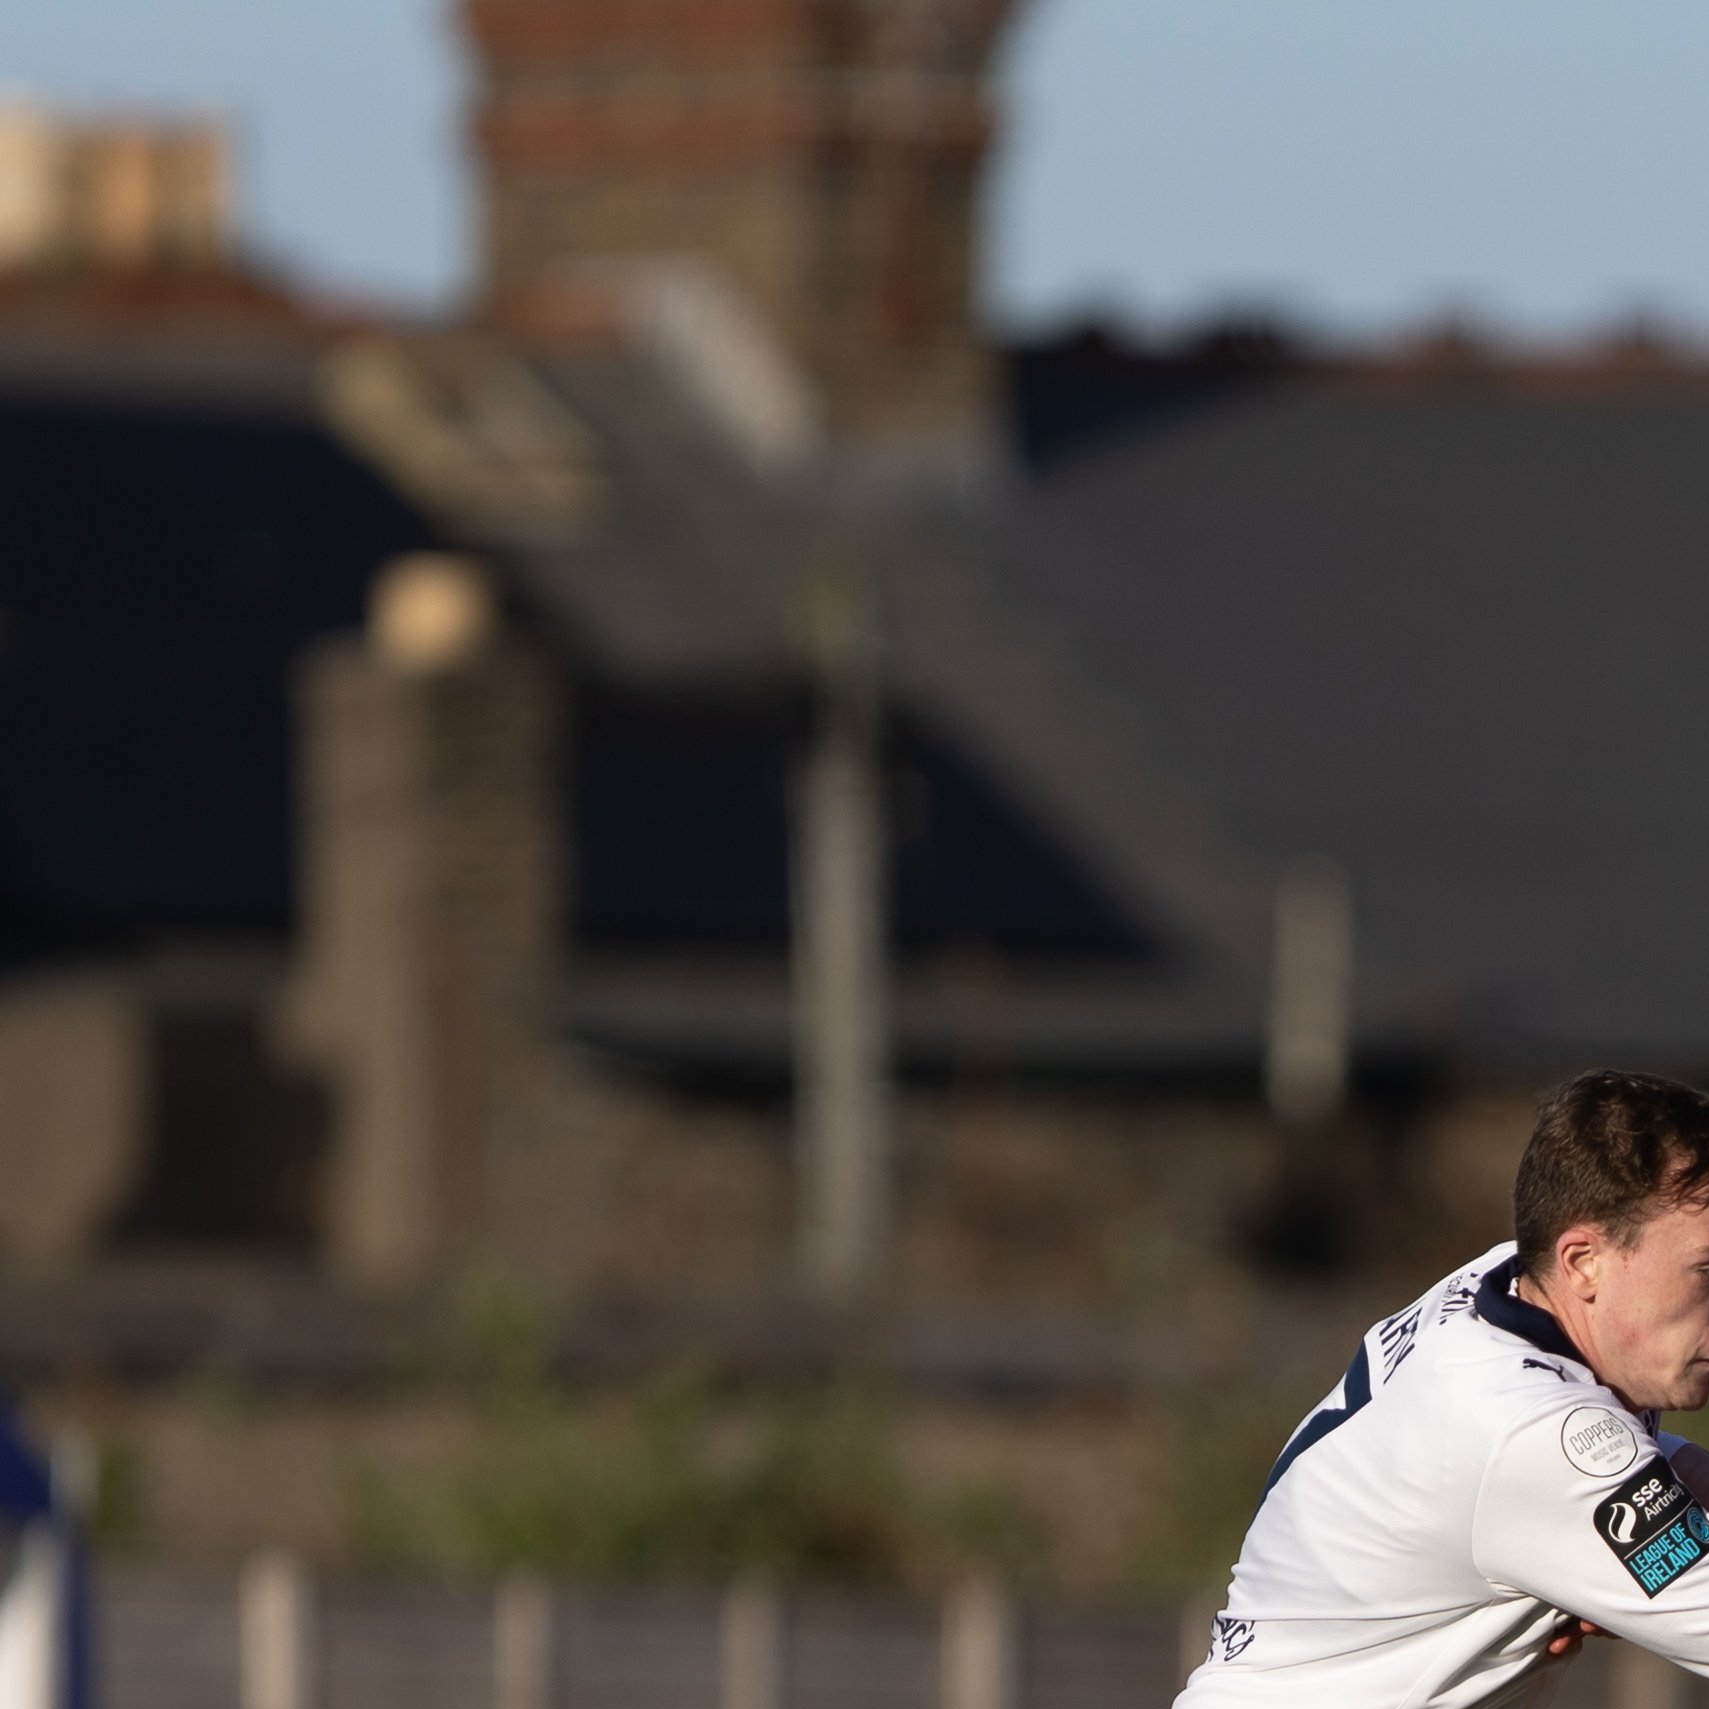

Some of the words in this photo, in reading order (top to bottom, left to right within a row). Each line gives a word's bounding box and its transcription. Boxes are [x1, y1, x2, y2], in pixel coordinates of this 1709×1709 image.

[1569, 1417, 1624, 1455] COPPERS
[1632, 1478, 1663, 1507] sse
[1629, 1533, 1675, 1576] LEAGUE
[1669, 1522, 1687, 1542] OF
[1640, 1537, 1700, 1592] IRELAND
